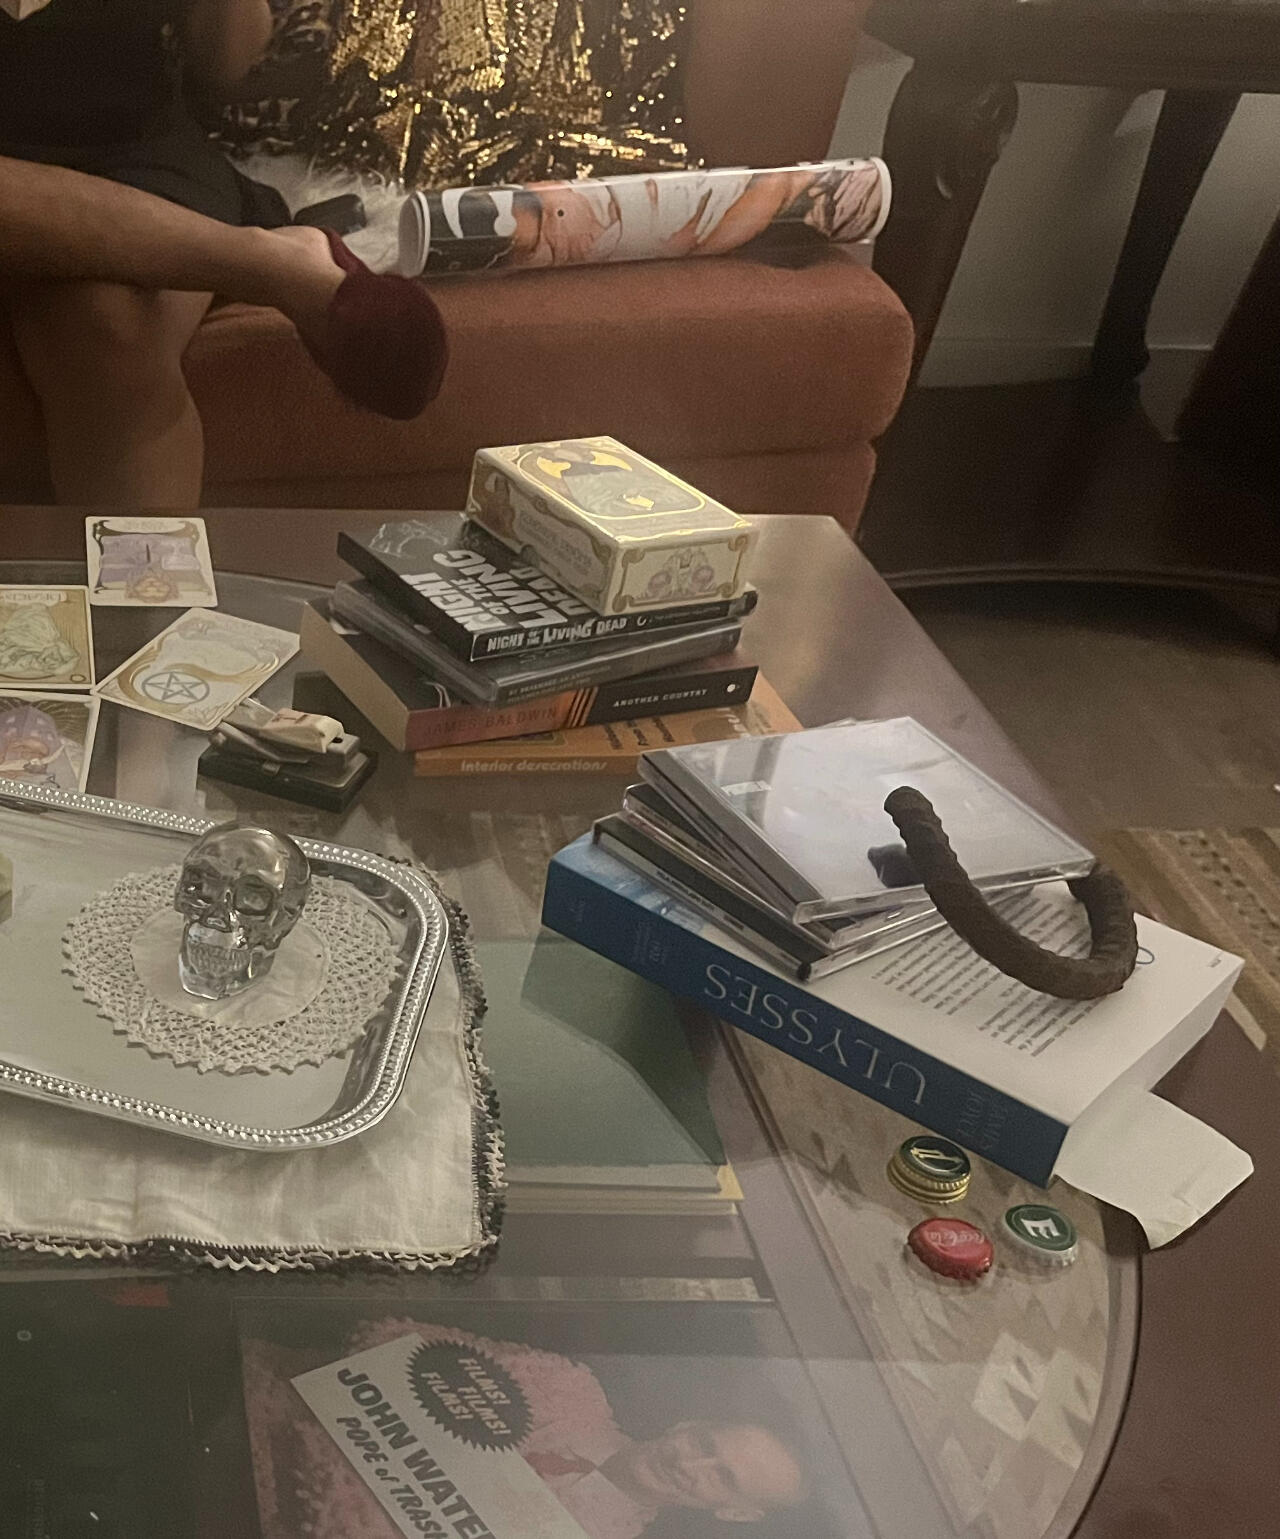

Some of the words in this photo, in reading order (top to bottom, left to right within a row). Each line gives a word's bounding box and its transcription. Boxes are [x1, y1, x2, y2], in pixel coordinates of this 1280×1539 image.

[400, 572, 507, 632] NIGHT
[433, 550, 568, 629] LIVING
[451, 577, 494, 600] THE
[481, 601, 510, 615] OF
[487, 632, 524, 652] NIGHT
[543, 617, 596, 644] LIVING
[596, 617, 627, 635] DEAD
[613, 693, 659, 708] ANOTHER
[663, 688, 707, 702] COUNTRY
[424, 715, 480, 738] JAMES
[485, 706, 558, 729] BALDWIN
[460, 758, 514, 772] Interior
[516, 758, 608, 772] desecrations
[704, 962, 927, 1105] ULYSSES
[421, 1371, 474, 1420] FILMS!
[458, 1357, 512, 1405] FILMS!
[458, 1387, 512, 1436] FILMS!
[336, 1416, 389, 1463] POPE
[336, 1367, 419, 1450] JOHN
[403, 1448, 497, 1539] WATE
